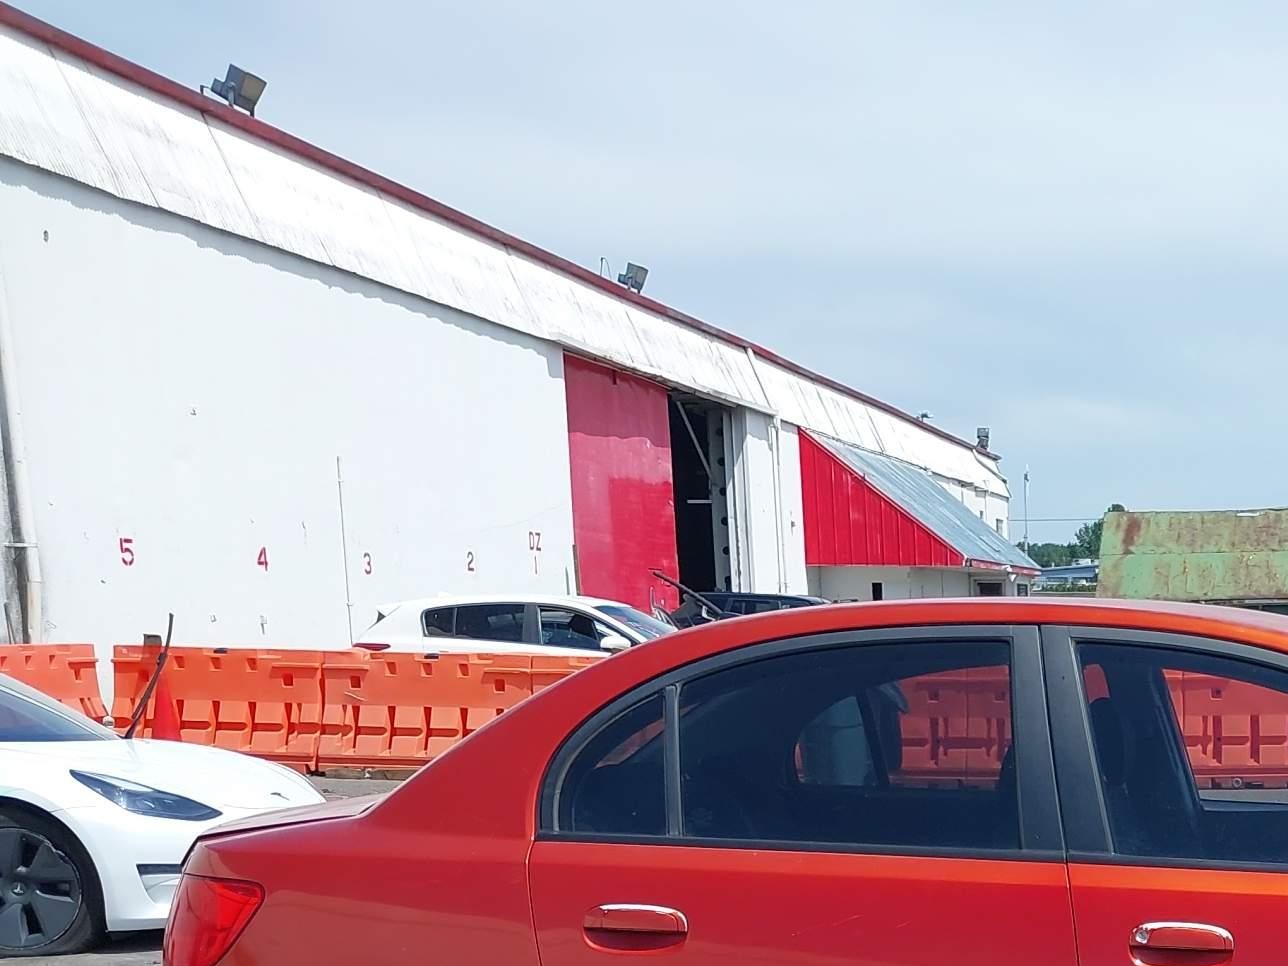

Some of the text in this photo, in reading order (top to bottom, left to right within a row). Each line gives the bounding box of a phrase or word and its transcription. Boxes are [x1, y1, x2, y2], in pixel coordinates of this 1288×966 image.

[119, 537, 135, 567] 5
[256, 546, 269, 572] 4
[363, 552, 372, 576] 3
[466, 551, 476, 572] 2
